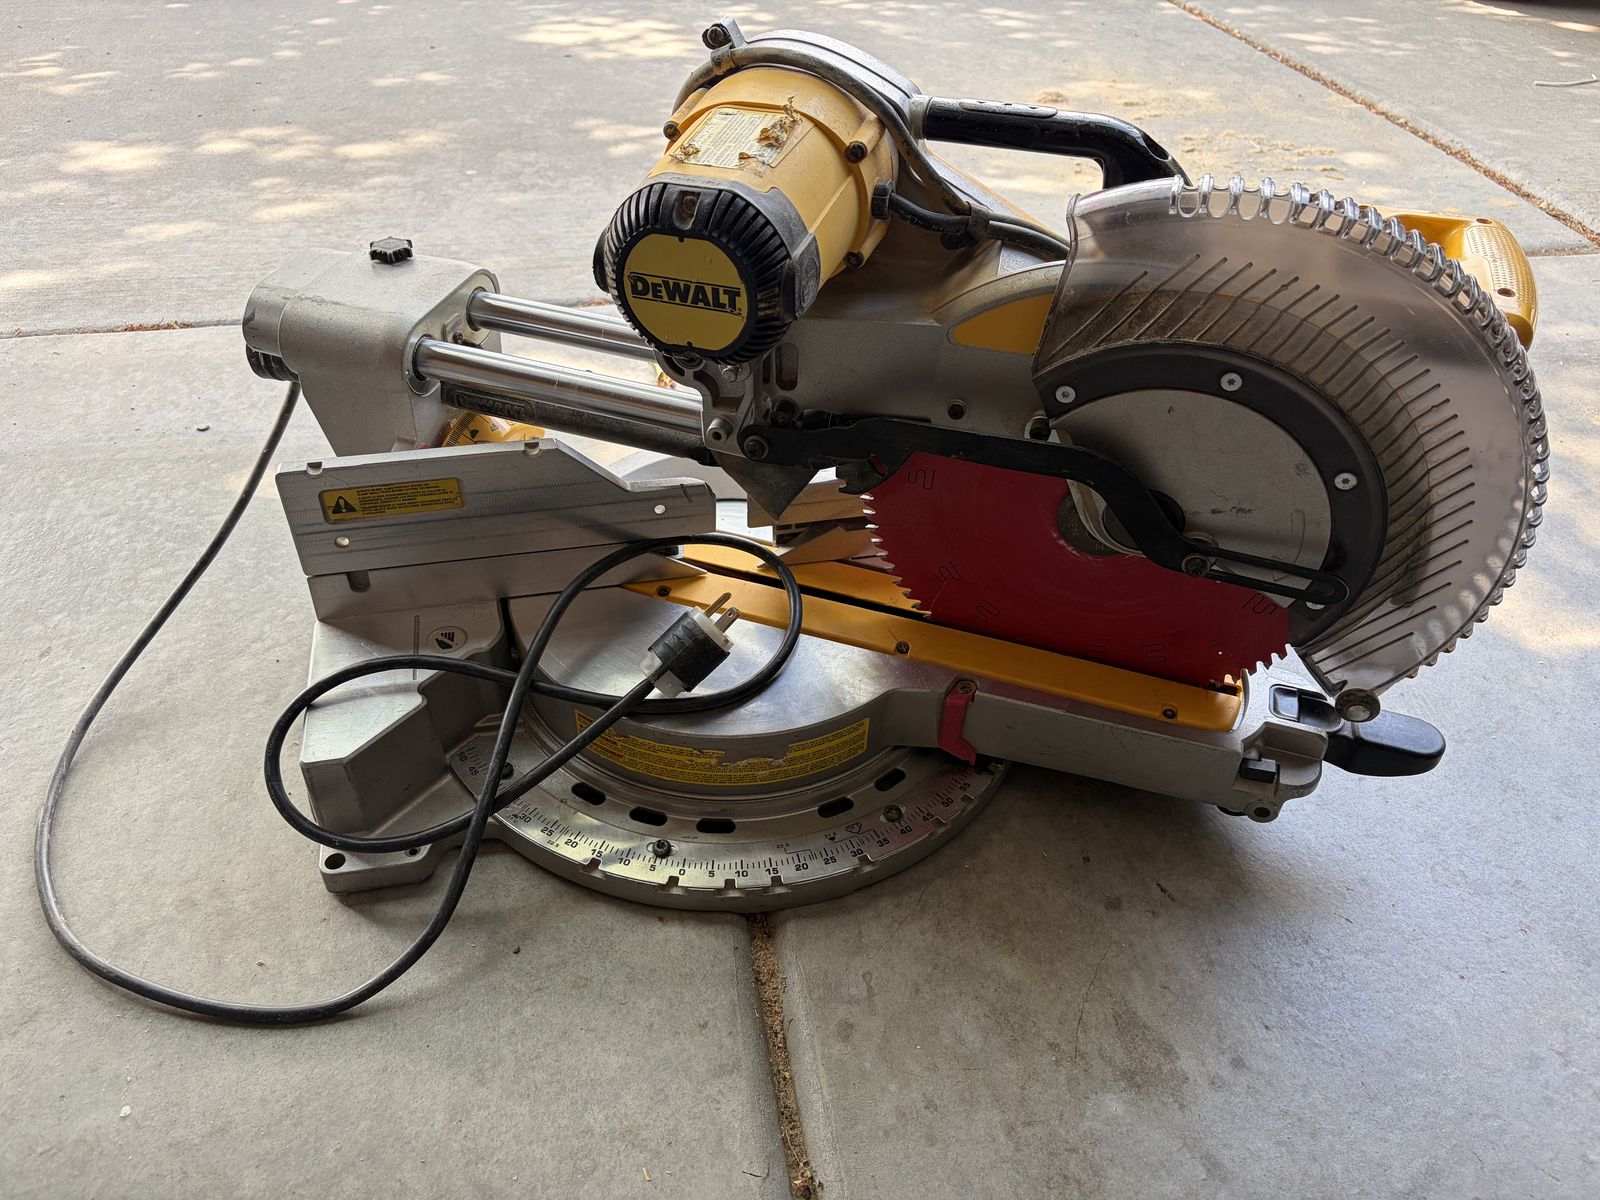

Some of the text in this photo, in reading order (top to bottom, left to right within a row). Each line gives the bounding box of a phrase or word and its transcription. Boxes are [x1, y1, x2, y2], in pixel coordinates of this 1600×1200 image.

[630, 275, 741, 312] DEWALT
[456, 751, 971, 878] 50 45 30 25 20 15 10 5 0 5 10 15 20 25 30 35 40 45 50 55
